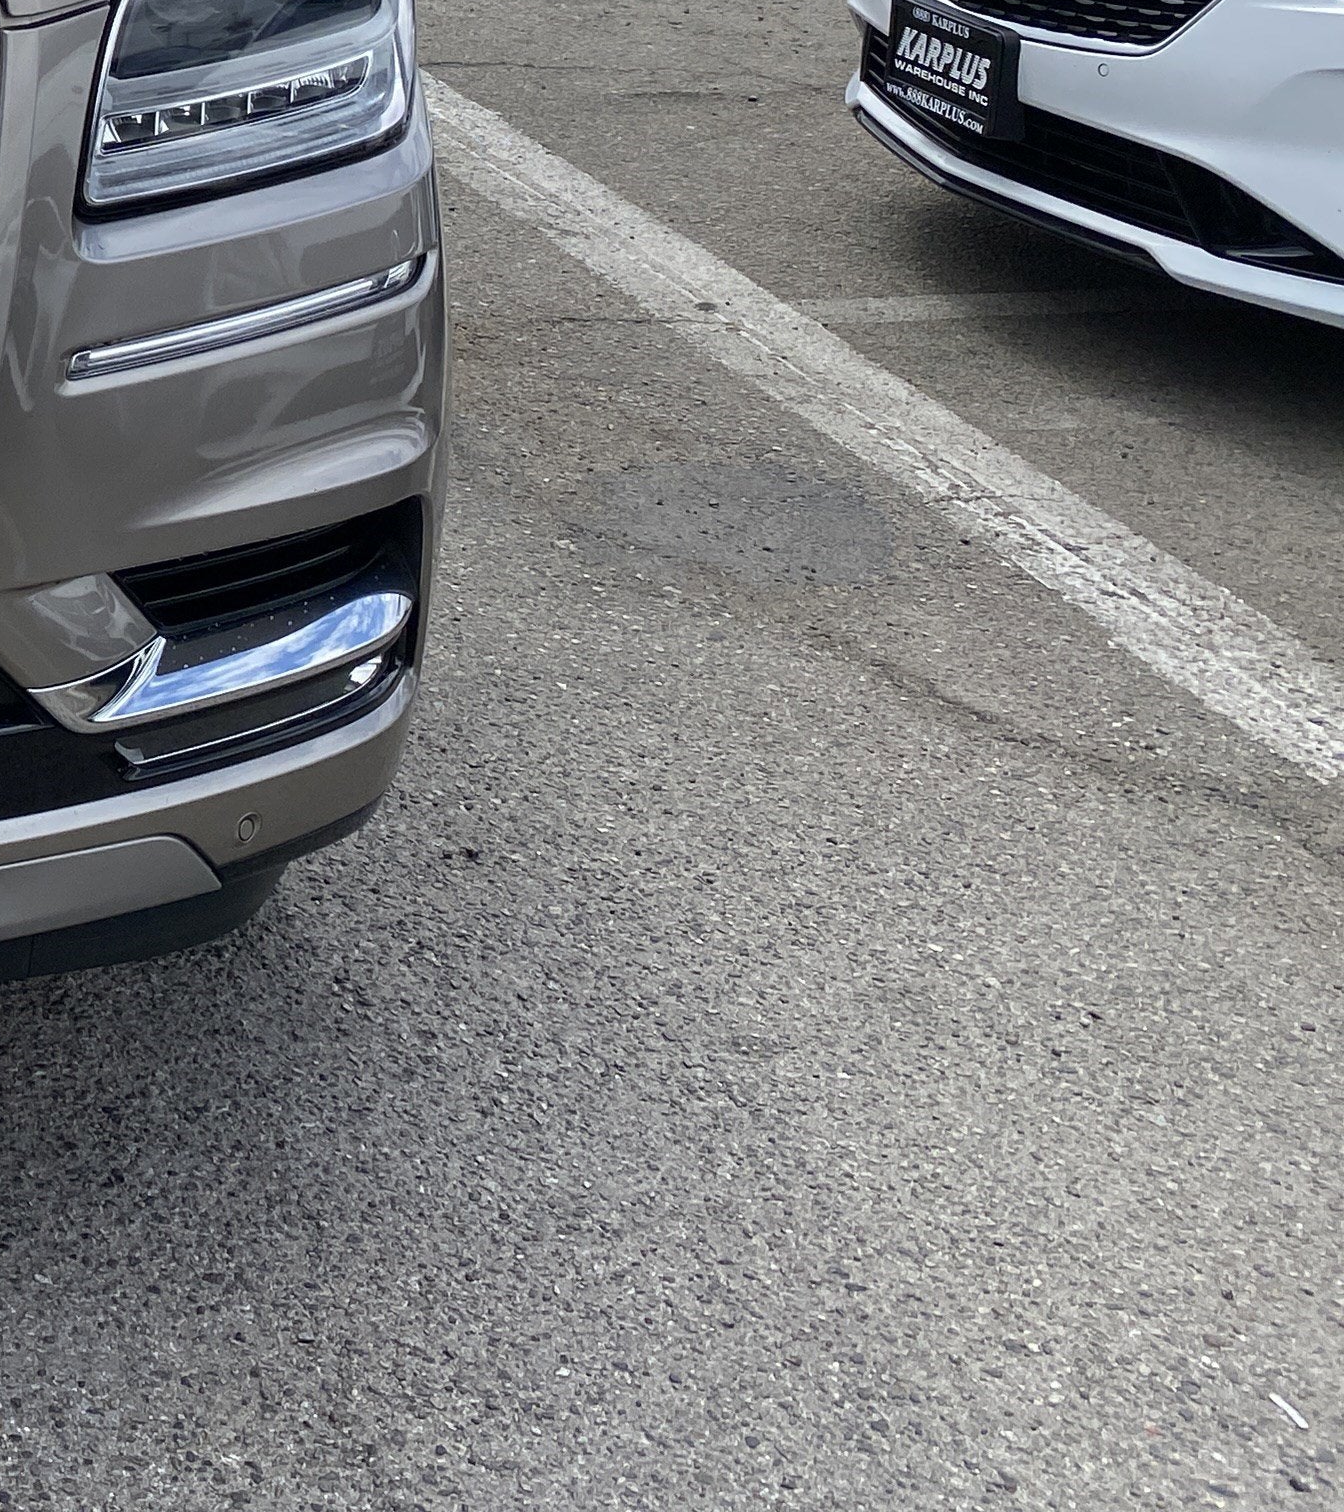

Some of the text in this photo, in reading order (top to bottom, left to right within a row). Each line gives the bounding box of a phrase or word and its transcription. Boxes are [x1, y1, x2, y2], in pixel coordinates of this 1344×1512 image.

[932, 14, 970, 39] KARPLUS
[894, 58, 989, 107] WAREHOUSE INC
[896, 26, 991, 90] KARPLUS
